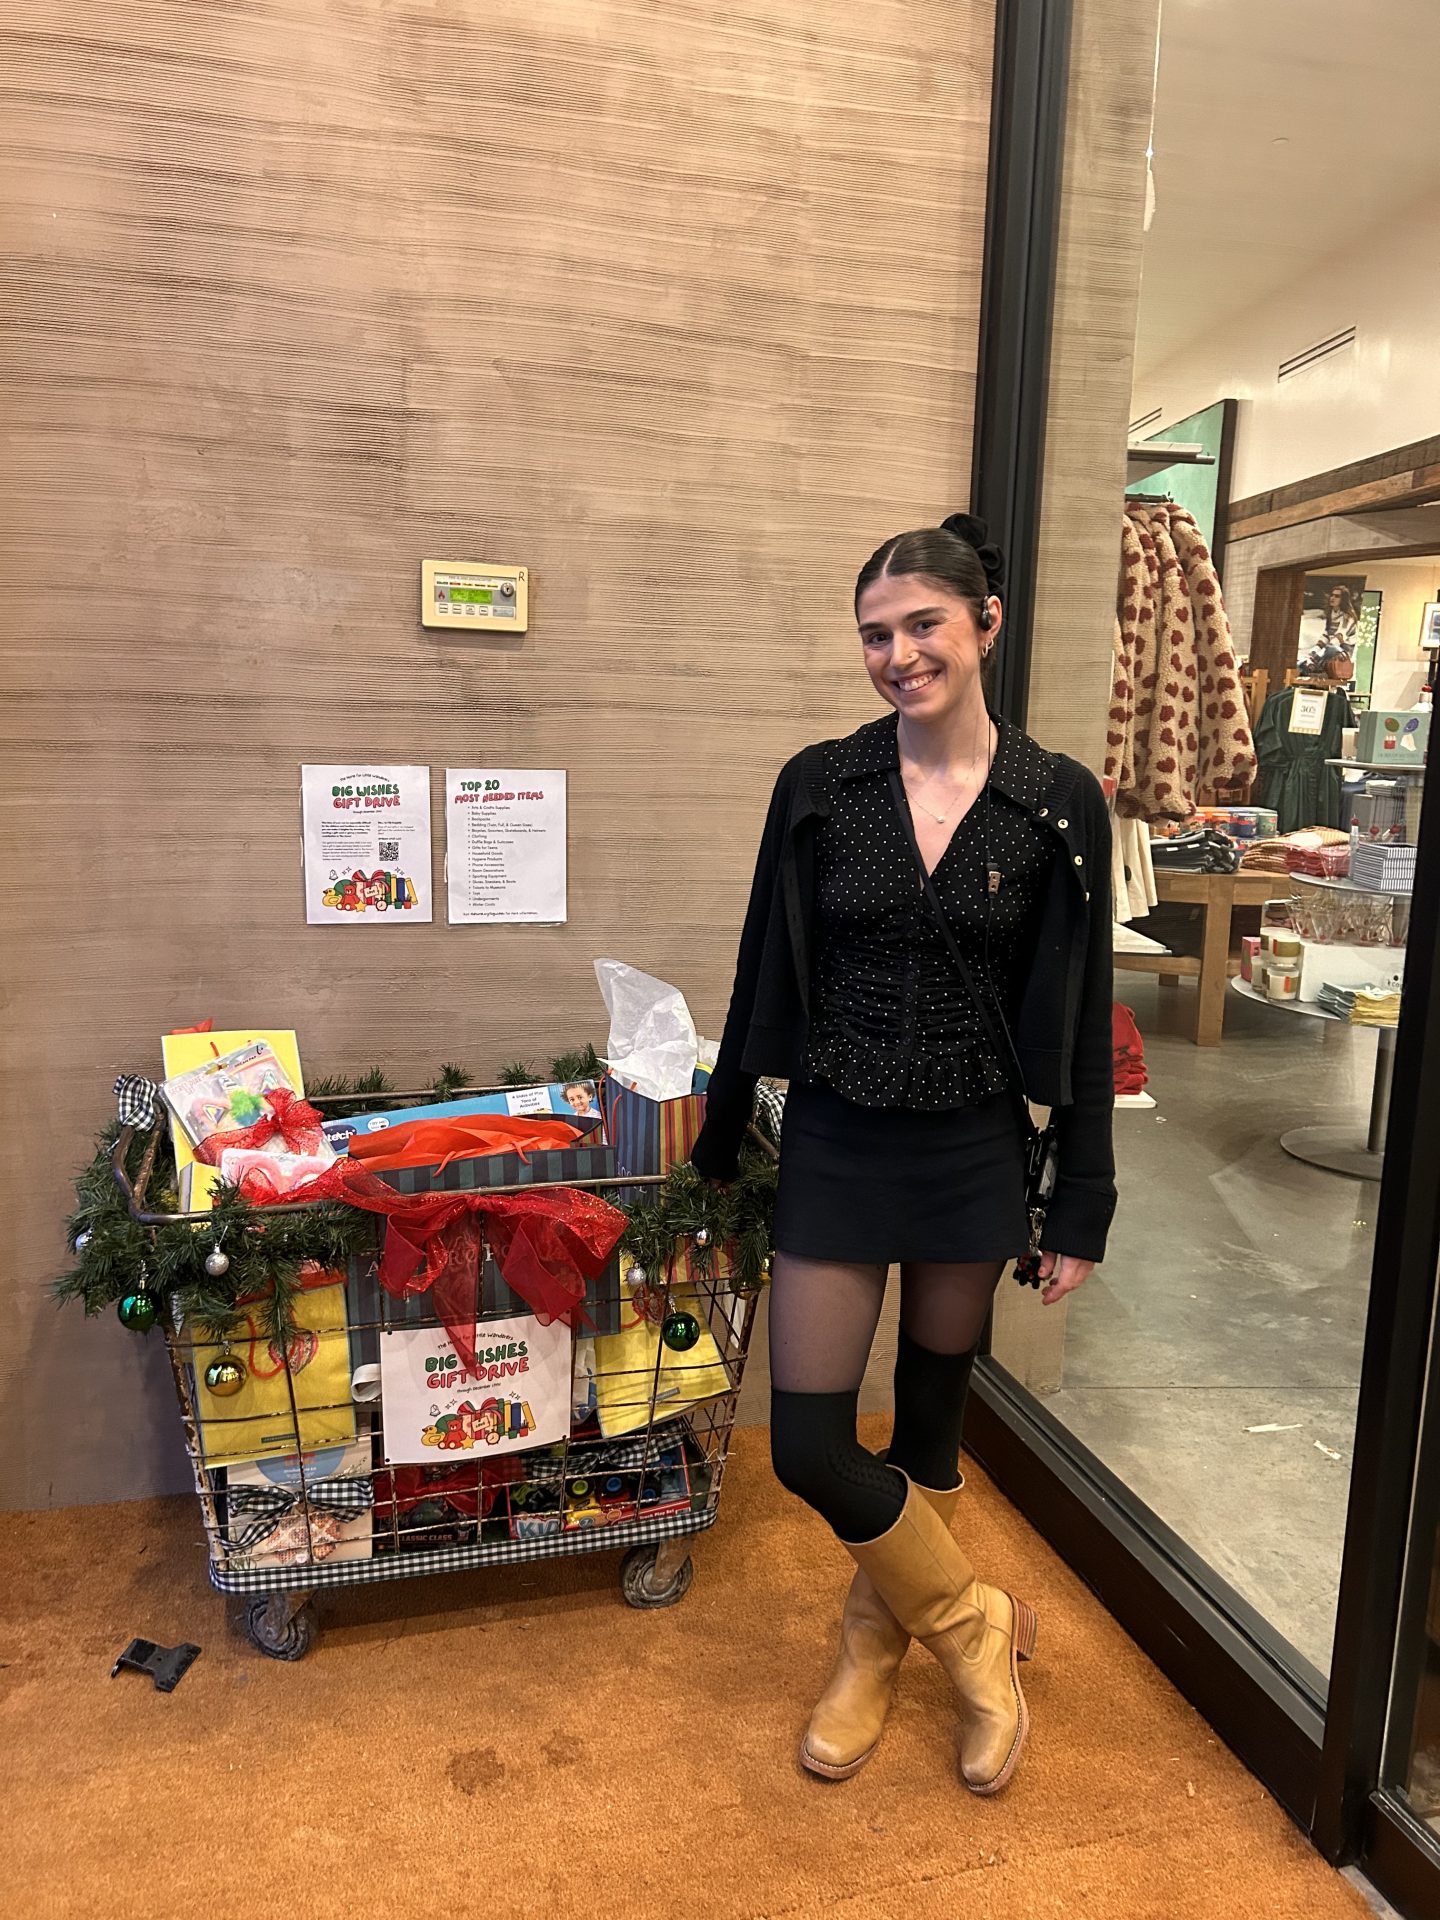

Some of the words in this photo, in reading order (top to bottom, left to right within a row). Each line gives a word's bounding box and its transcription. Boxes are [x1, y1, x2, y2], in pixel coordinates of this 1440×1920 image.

[332, 786, 353, 797] BIG
[356, 784, 399, 796] WISHES
[460, 782, 482, 792] TOP
[484, 780, 500, 790] 20
[333, 797, 361, 809] GIFT
[365, 795, 400, 809] DRIVE
[455, 794, 480, 804] MOST
[482, 792, 515, 802] NEEDED
[517, 791, 544, 800] ITEMS
[327, 1130, 353, 1142] tech
[425, 1354, 458, 1372] BIG
[427, 1368, 469, 1389] GIFT
[475, 1357, 529, 1381] DRIVE
